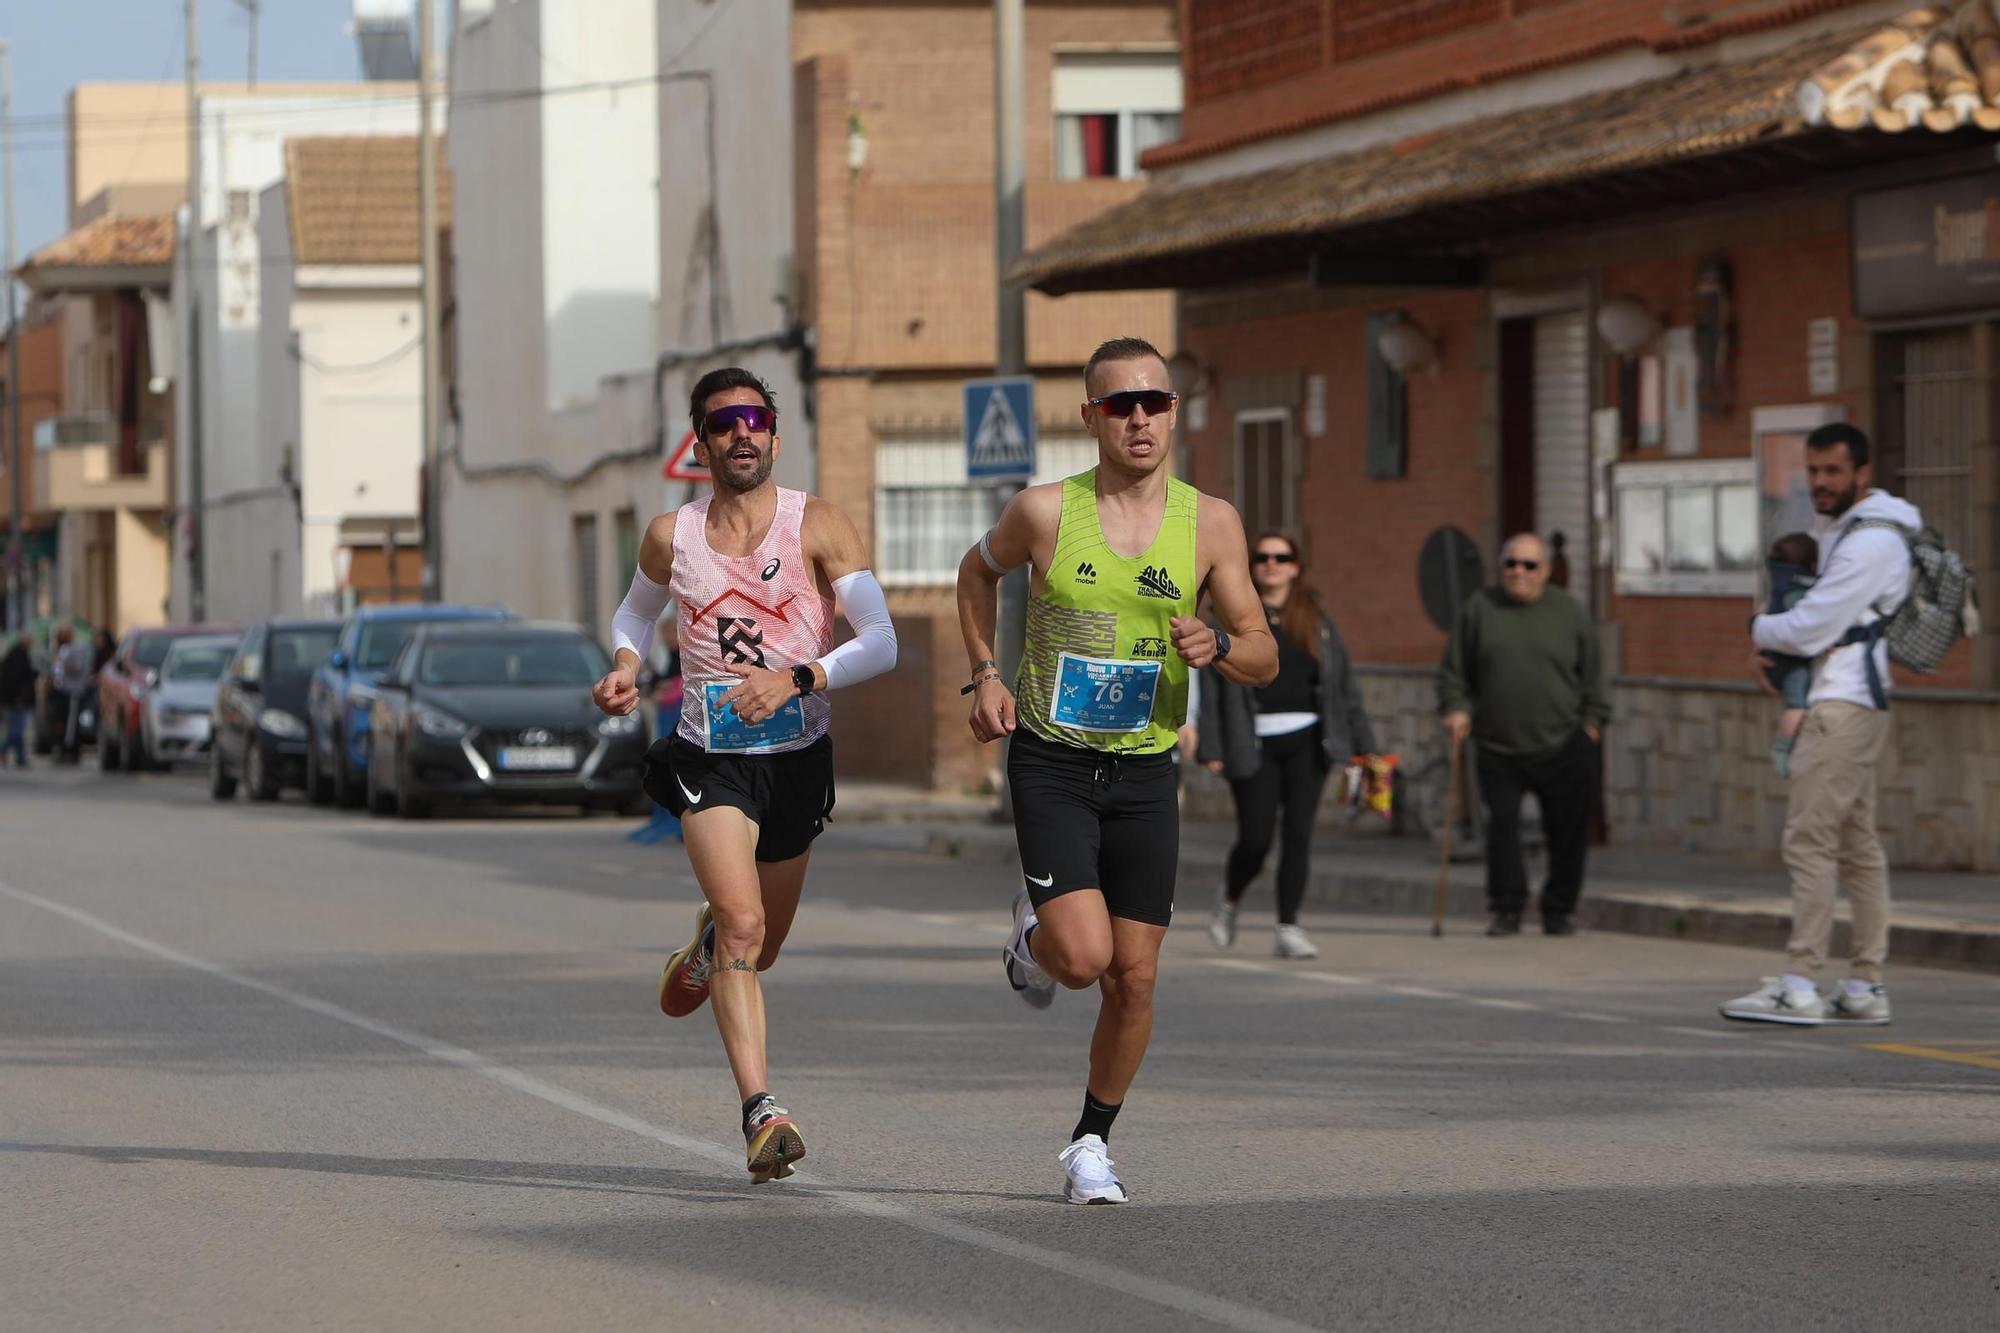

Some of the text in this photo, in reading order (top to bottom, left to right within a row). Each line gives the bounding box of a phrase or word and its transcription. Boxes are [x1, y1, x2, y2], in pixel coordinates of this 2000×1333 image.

[1075, 577, 1096, 586] mobel
[1141, 565, 1181, 597] ALGAR
[1094, 681, 1124, 703] 76
